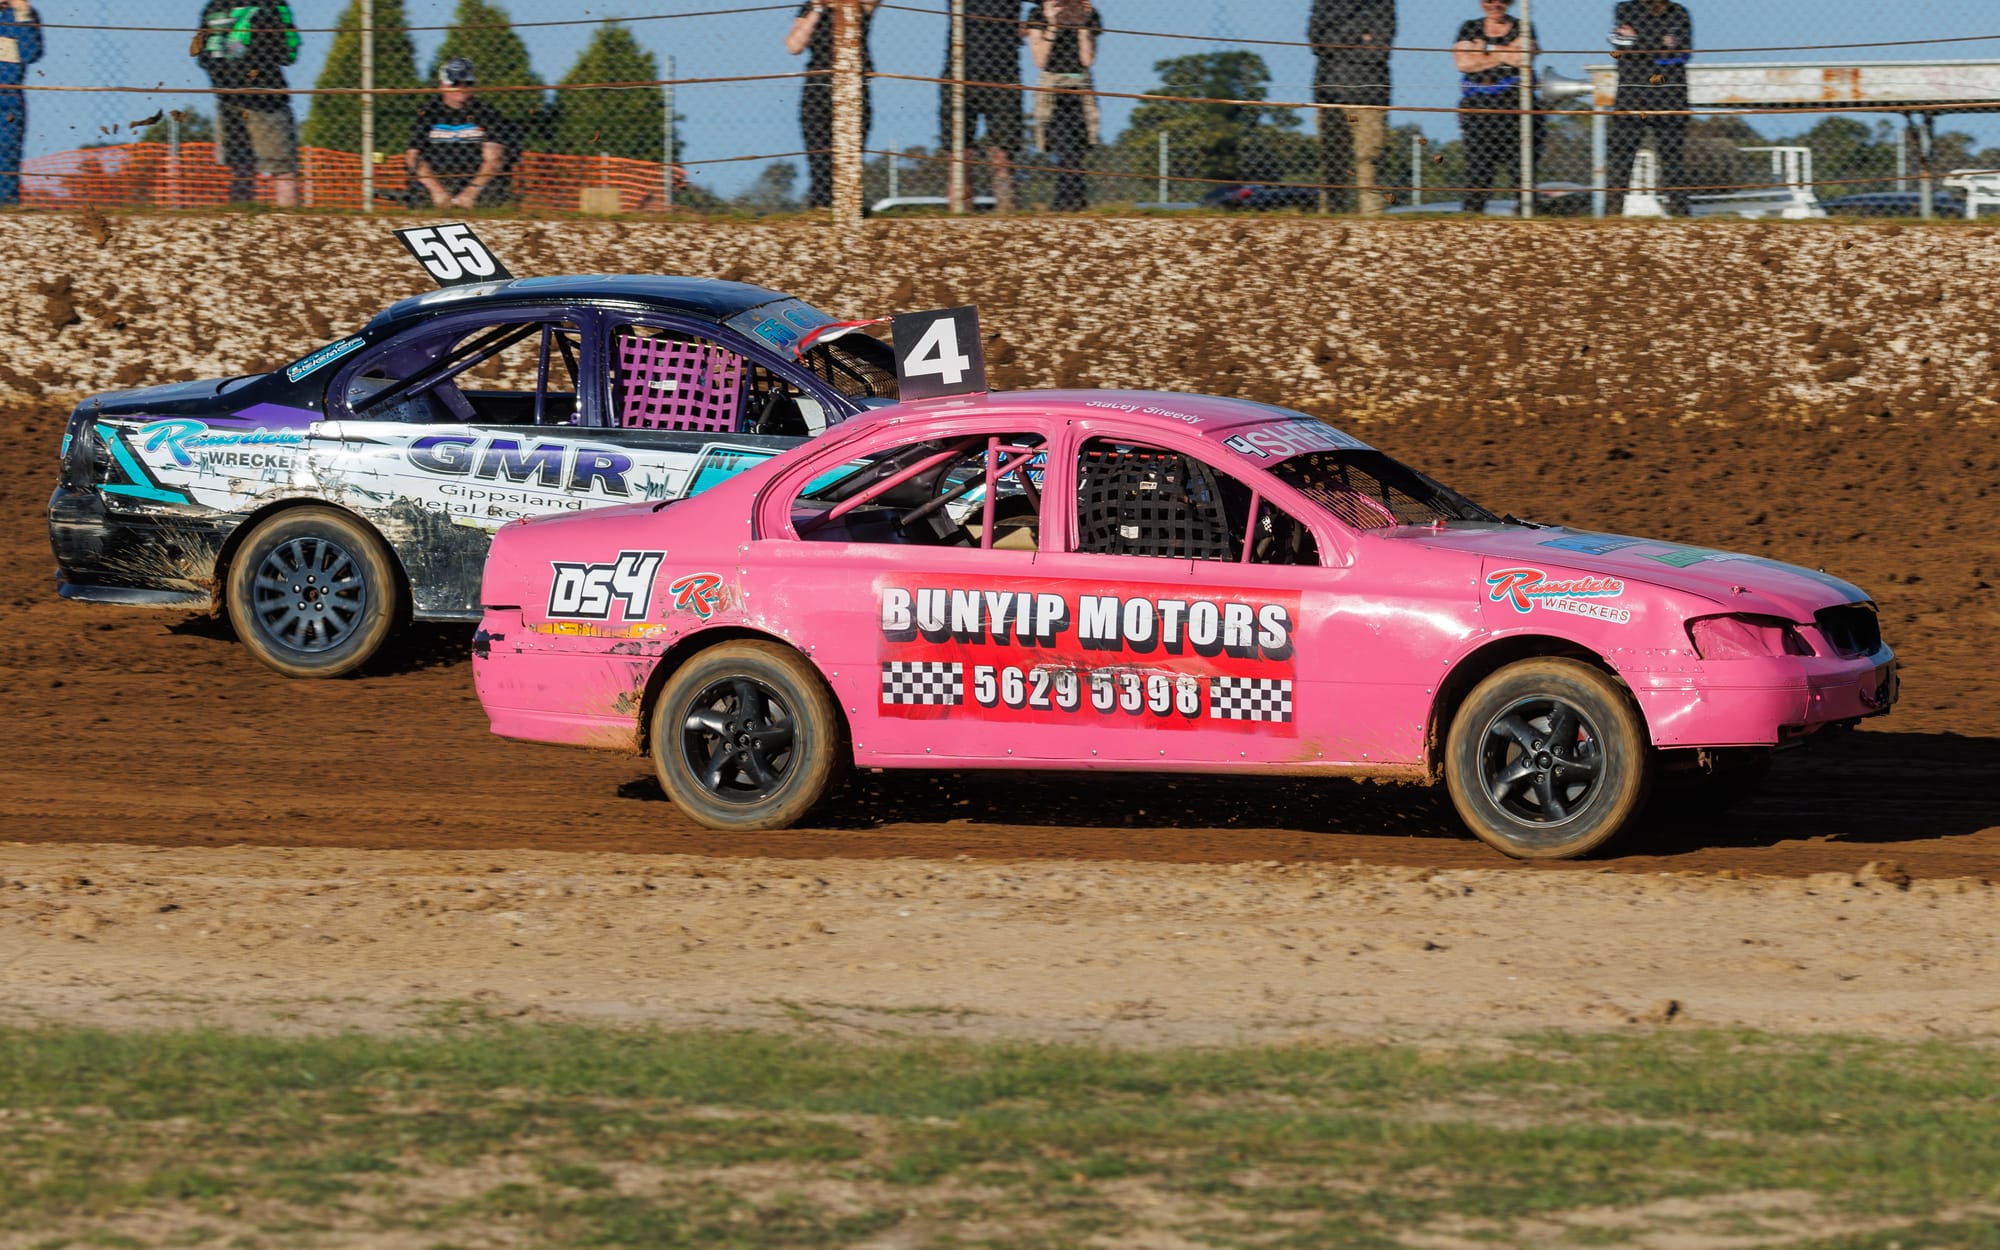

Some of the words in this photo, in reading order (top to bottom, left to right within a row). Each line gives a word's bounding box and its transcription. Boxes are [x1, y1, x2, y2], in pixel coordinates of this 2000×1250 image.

[403, 224, 496, 280] 55
[903, 317, 970, 385] 4
[138, 418, 305, 468] Ramsdale
[406, 435, 635, 497] GMR
[1223, 435, 1271, 459] 4
[400, 495, 476, 516] Metal
[438, 484, 583, 510] Gippsland
[549, 551, 666, 620] DS4
[1487, 569, 1624, 613] Ramsdale
[1545, 597, 1629, 622] WRECKERS
[881, 586, 1068, 646] BUNYIP
[1078, 595, 1293, 657] MOTORS
[973, 665, 1080, 711] 5629
[1090, 672, 1200, 717] 5398
